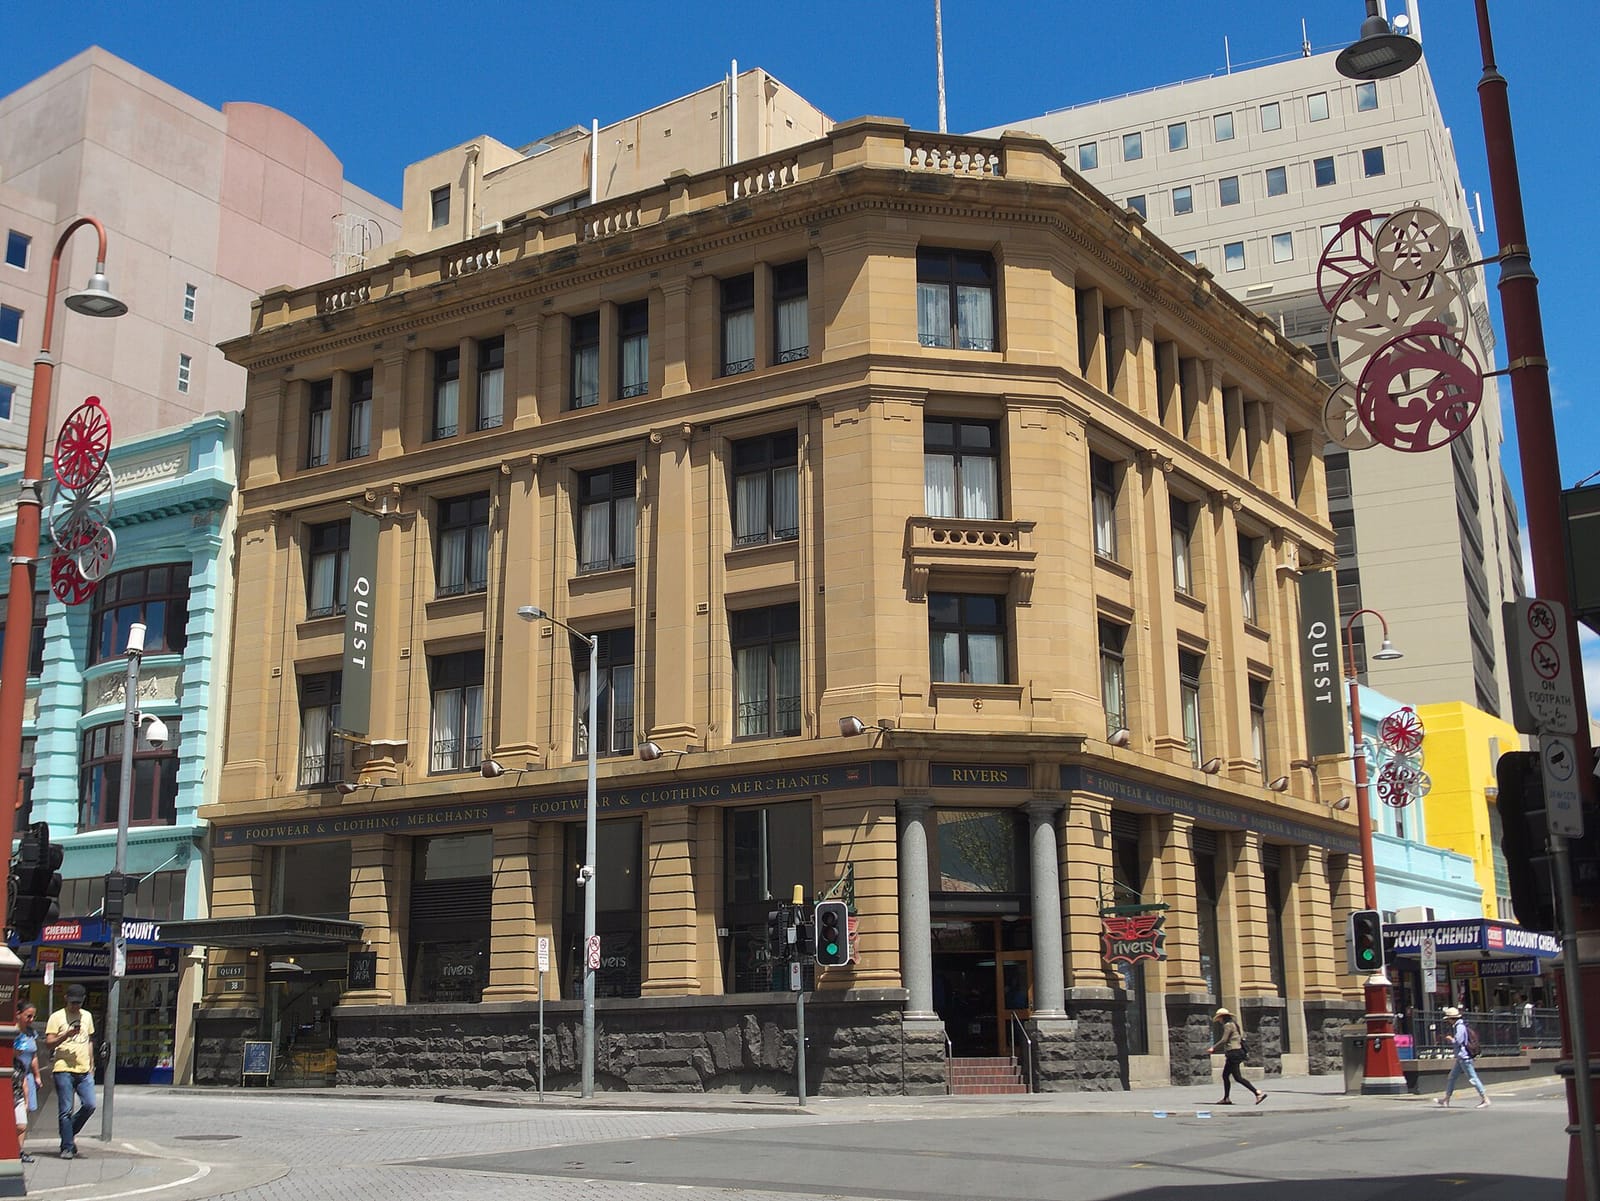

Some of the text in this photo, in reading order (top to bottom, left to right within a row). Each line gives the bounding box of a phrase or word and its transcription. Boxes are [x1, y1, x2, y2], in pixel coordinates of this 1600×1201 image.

[353, 576, 370, 670] QUEST
[1307, 621, 1332, 704] QUEST
[1541, 680, 1556, 691] ON
[1528, 691, 1572, 705] FOOTPATH
[952, 769, 1008, 782] RIVERS
[532, 796, 610, 814] FOOTWER
[619, 796, 631, 806] &
[641, 785, 720, 804] CLOTHING
[730, 773, 830, 794] MERCHANTS
[1098, 778, 1142, 799] FOOTWEAR
[1155, 794, 1194, 811] CLOTHING
[246, 824, 309, 839] FOOTWEAR
[317, 823, 326, 833] &
[334, 817, 399, 832] CLOTHING
[407, 808, 489, 825] MERCHANTS
[45, 925, 80, 936] CHEMIST
[1436, 926, 1481, 945] CHEMIST
[1505, 930, 1538, 949] DISCOUNT
[1113, 941, 1154, 954] rivers
[601, 956, 627, 968] vers
[1510, 960, 1534, 973] CHEMIST
[220, 967, 241, 976] QUEST
[443, 963, 474, 976] rivers
